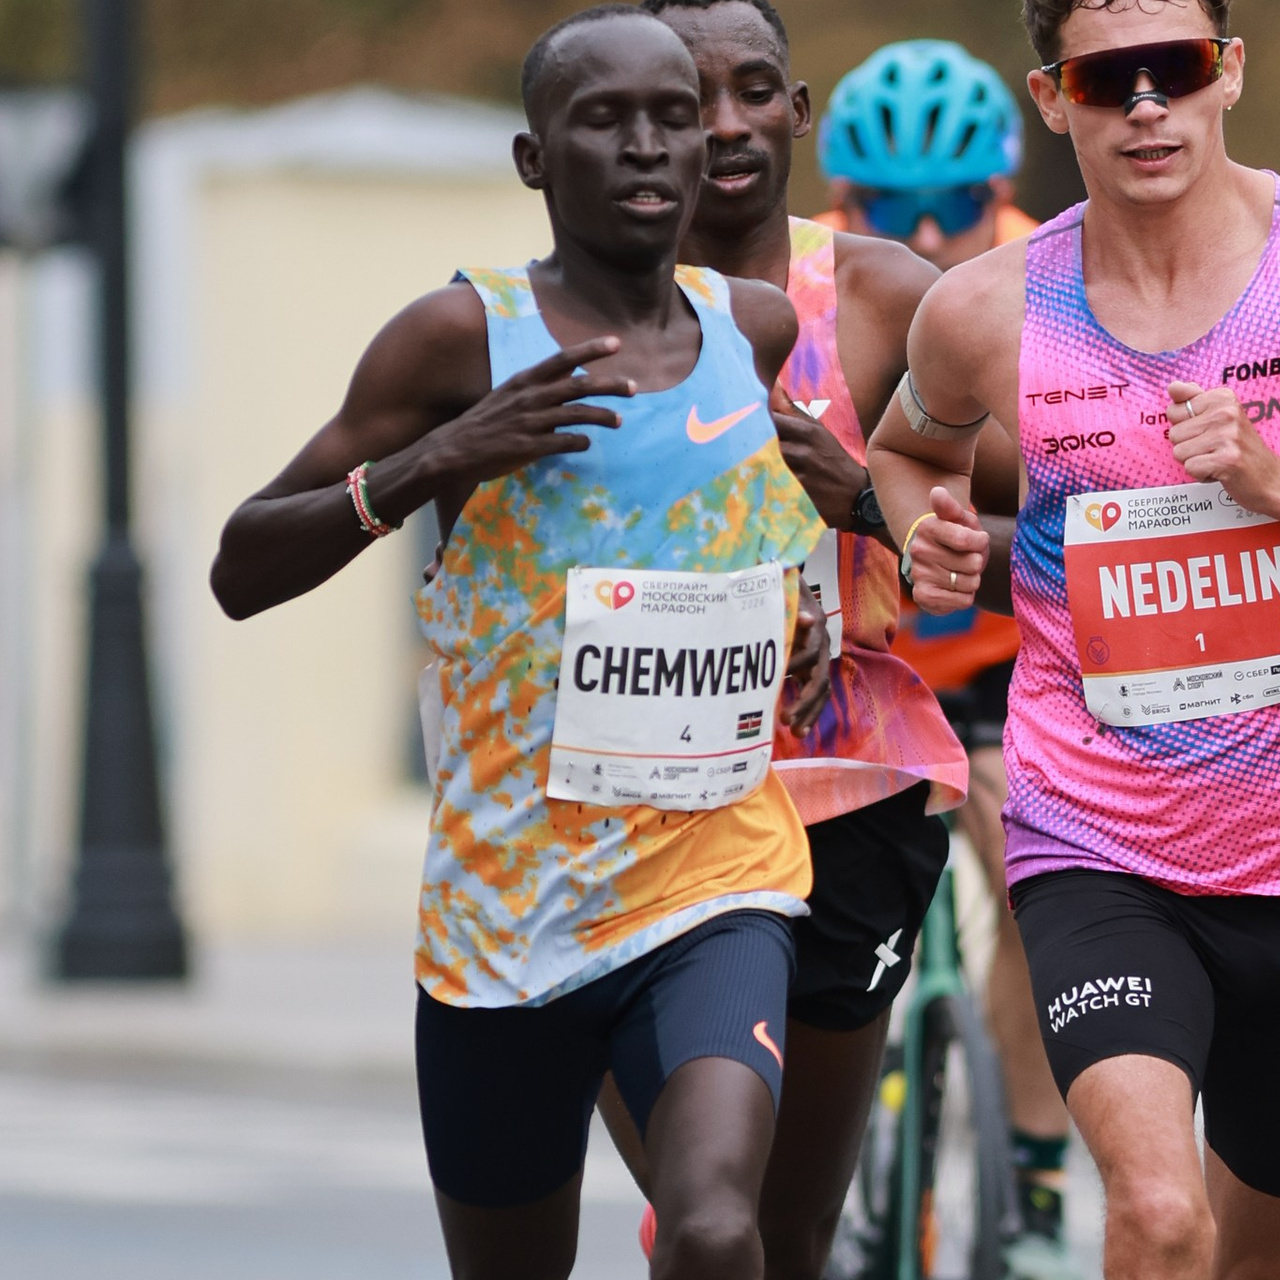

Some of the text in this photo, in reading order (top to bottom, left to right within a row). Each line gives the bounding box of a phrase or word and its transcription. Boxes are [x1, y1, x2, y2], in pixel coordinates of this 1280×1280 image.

[1026, 383, 1130, 406] TENET
[1128, 494, 1188, 507] СБЕРПРАЙМ
[1128, 500, 1213, 518] МОСКОВСКИЙ
[1128, 515, 1191, 531] МАРАФОН
[642, 580, 709, 591] СБЕРПРАЙМ
[642, 591, 728, 603] МОСКОВСКИЙ
[641, 603, 706, 615] МАРАФОН
[1195, 632, 1206, 652] 1
[573, 639, 776, 697] CHEMWENO
[1246, 669, 1269, 679] СБЕР
[680, 724, 692, 743] 4
[1048, 976, 1152, 1019] HUAWEI
[1051, 993, 1120, 1033] WATCH
